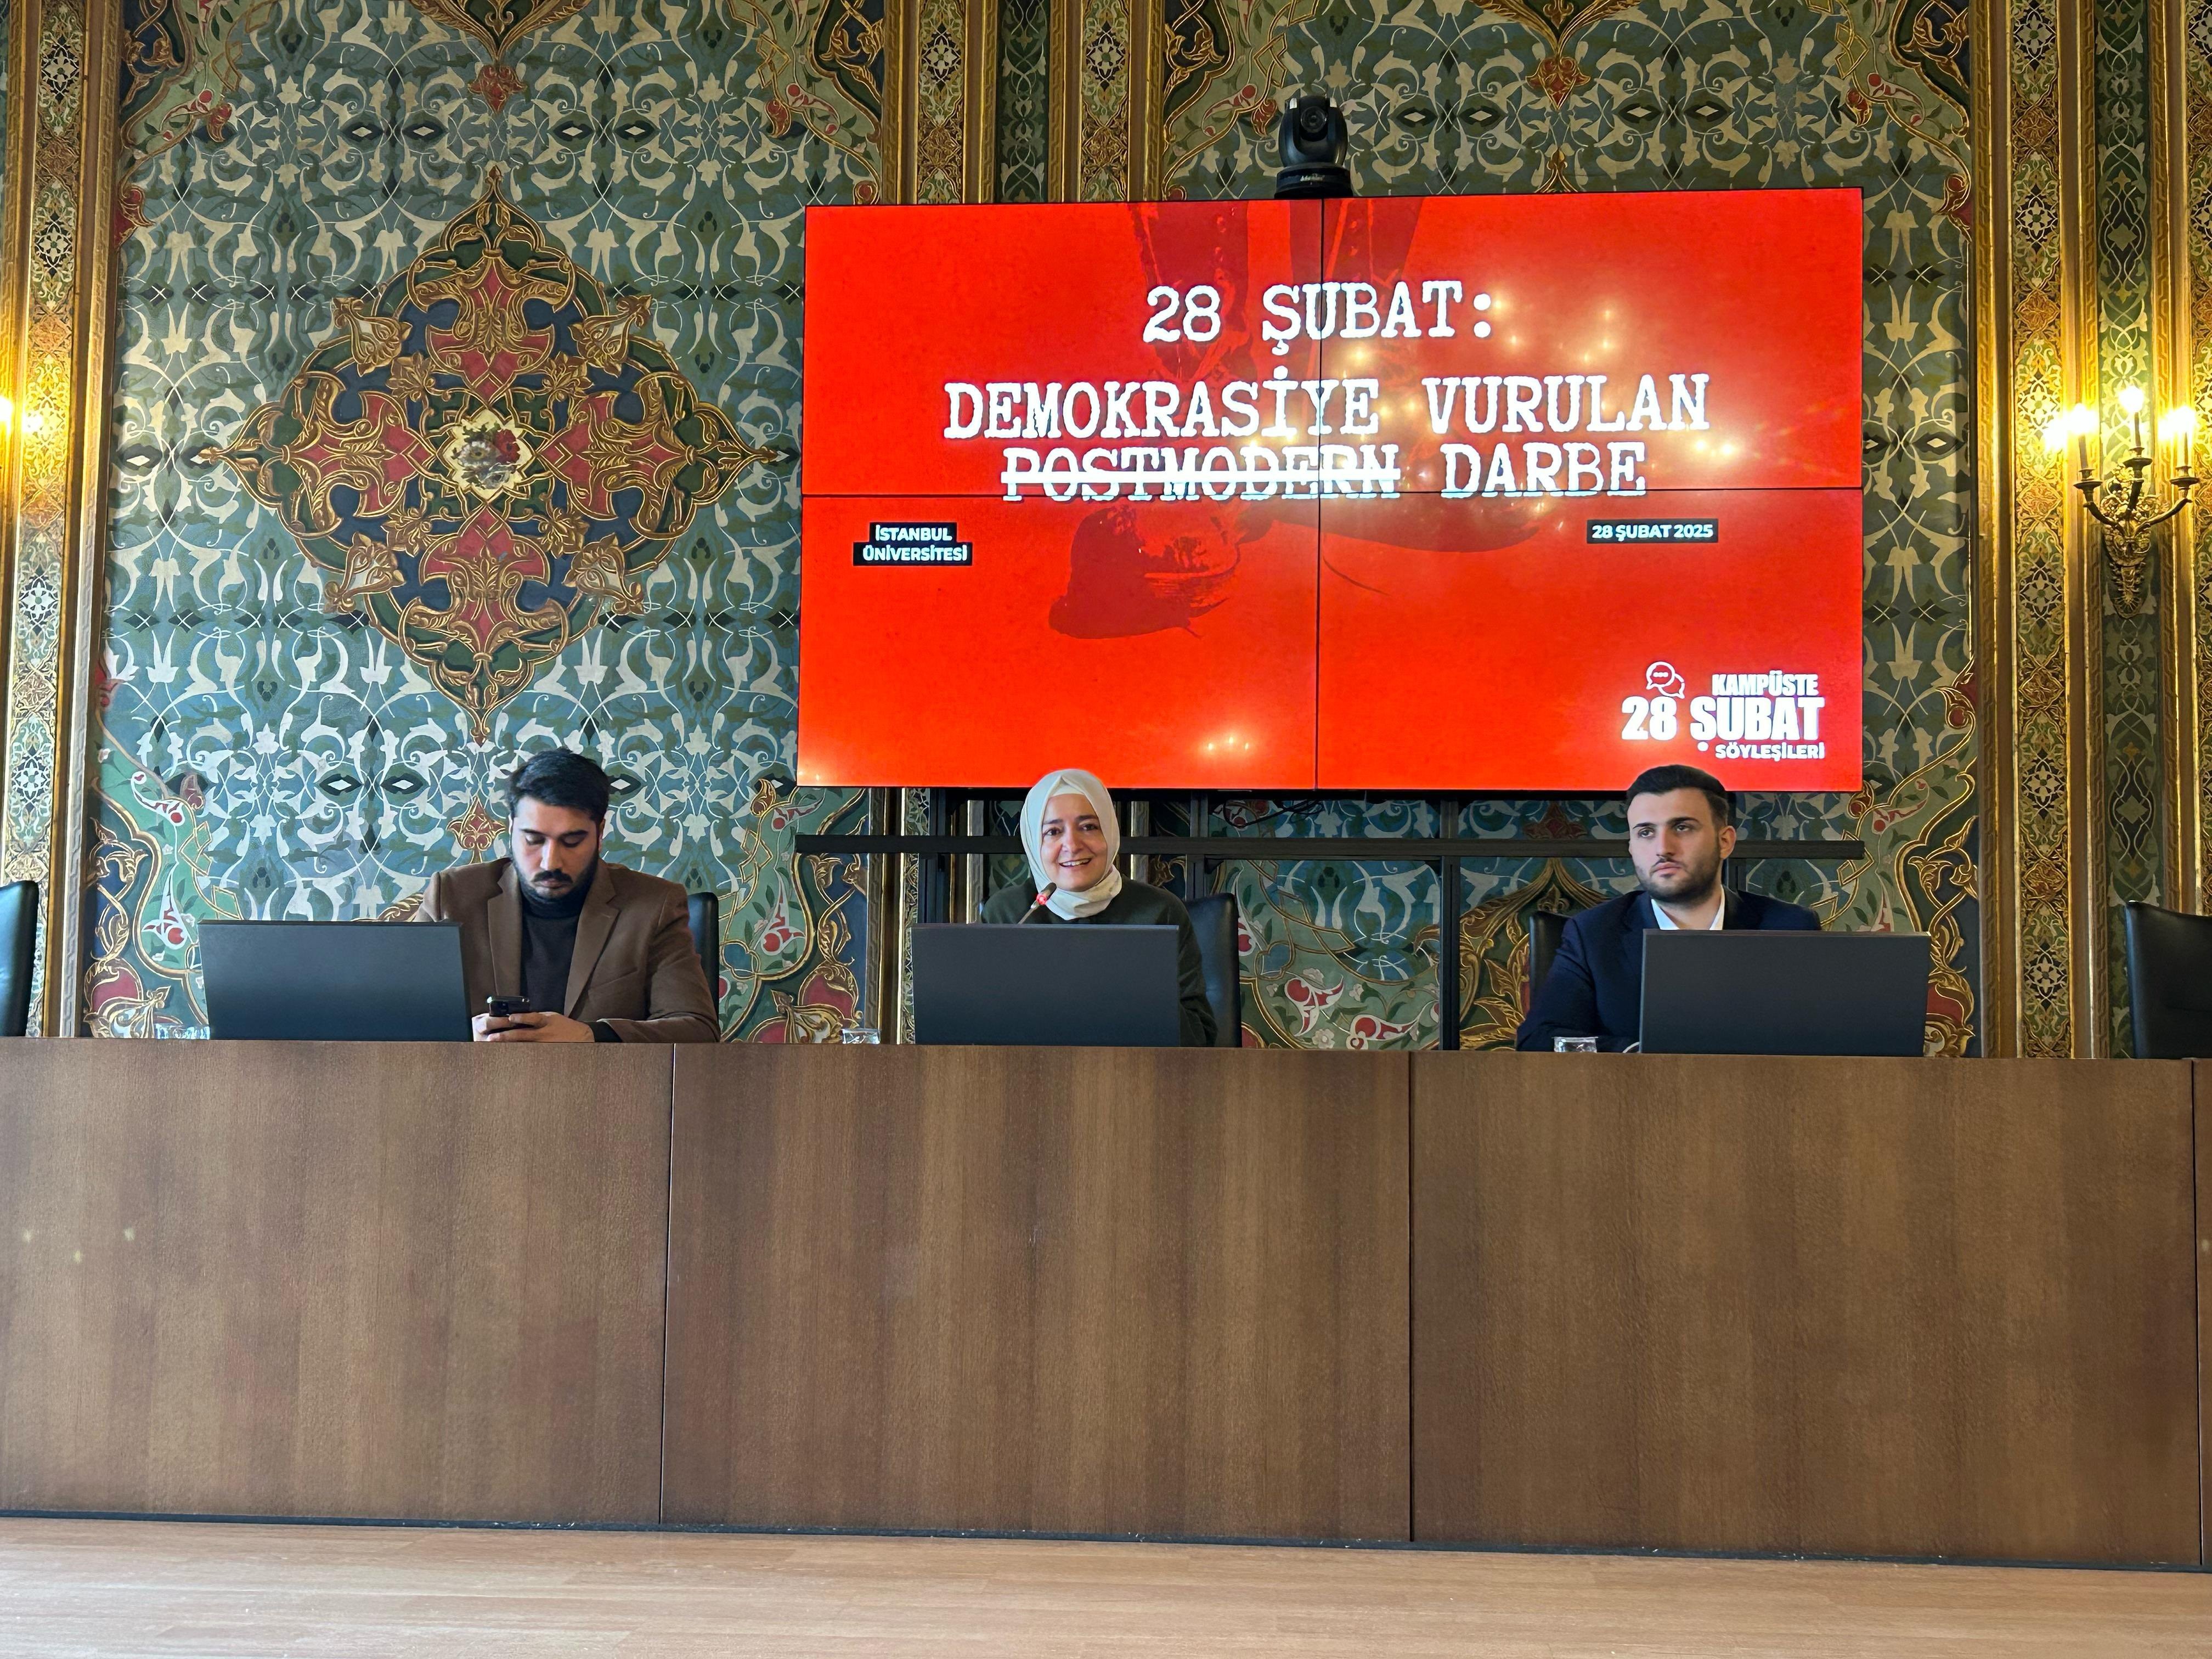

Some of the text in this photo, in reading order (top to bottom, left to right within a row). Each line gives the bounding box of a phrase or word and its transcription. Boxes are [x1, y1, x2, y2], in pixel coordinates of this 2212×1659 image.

[1143, 280, 1492, 355] 28 ŞUBAT:
[944, 366, 1710, 439] DEMOKRASİYE VURULAN
[1001, 441, 1646, 501] POSTMODERN DARBE
[875, 524, 953, 541] İSTANBUL
[1592, 524, 1714, 542] 28 ŞUBAT 2025
[862, 544, 968, 561] ÜNİVERSİTESİ
[1712, 670, 1819, 696] KAMPÜSTE
[1621, 695, 1825, 752] 28 ŞUBAT
[1715, 742, 1825, 762] SÖYLEŞİLERİ
